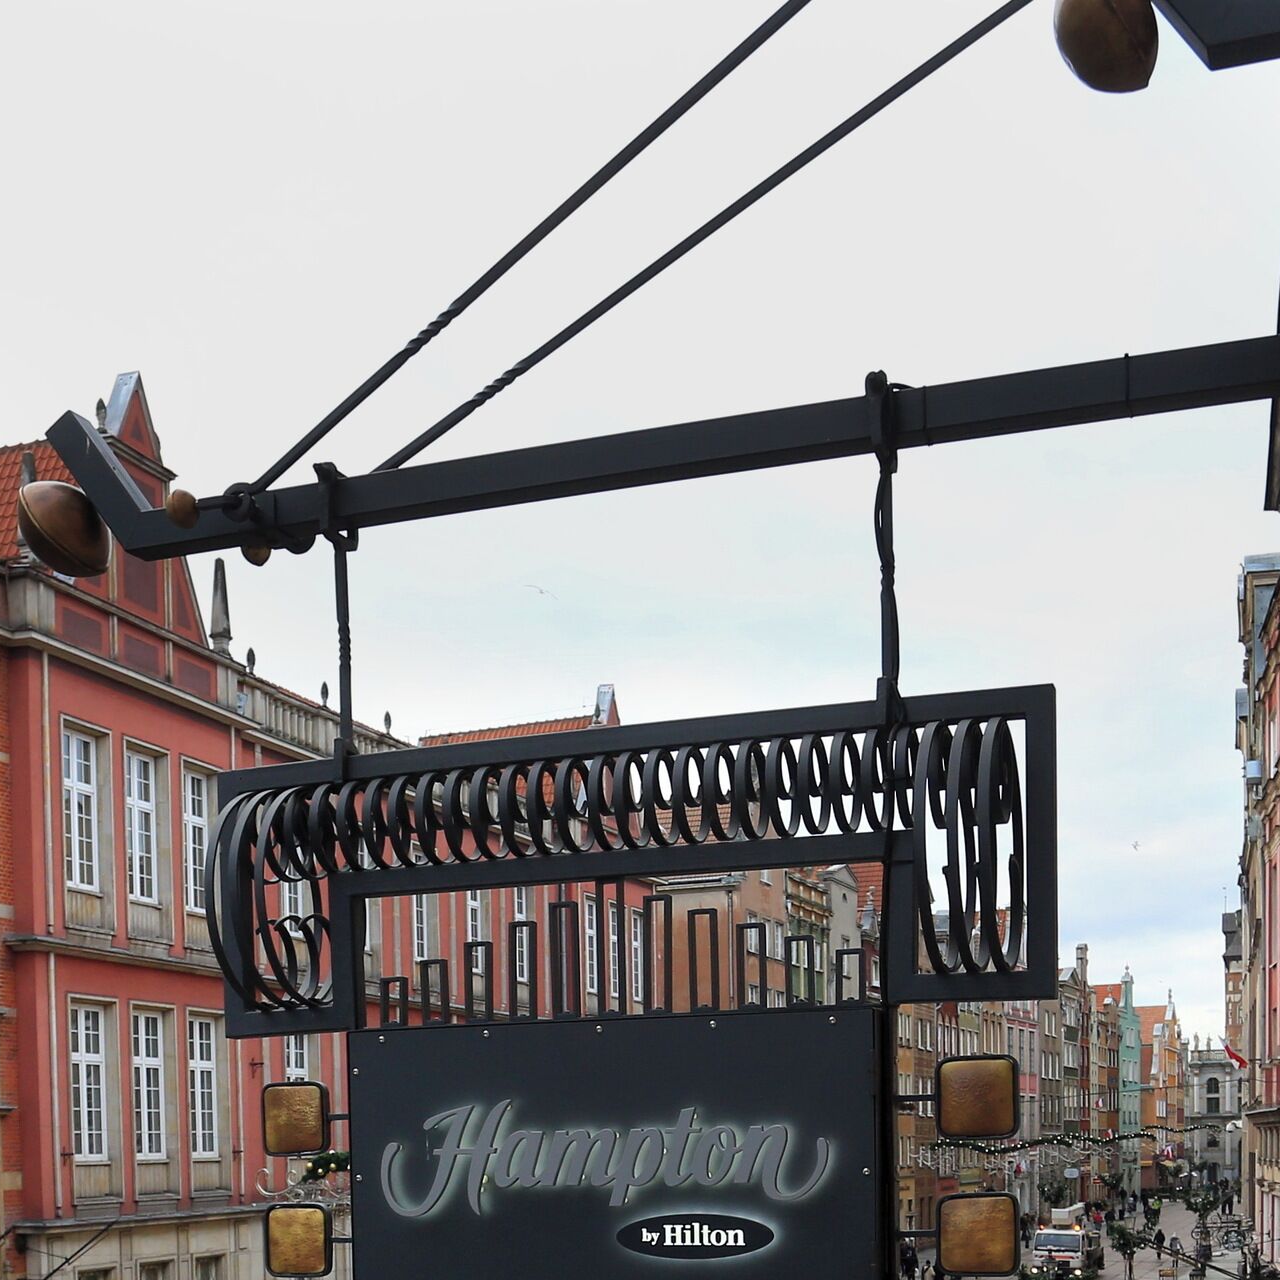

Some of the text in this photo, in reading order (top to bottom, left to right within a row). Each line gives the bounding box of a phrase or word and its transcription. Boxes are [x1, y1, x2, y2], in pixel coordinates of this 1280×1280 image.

[380, 1098, 830, 1217] Hampton
[641, 1222, 746, 1247] by Hilton
